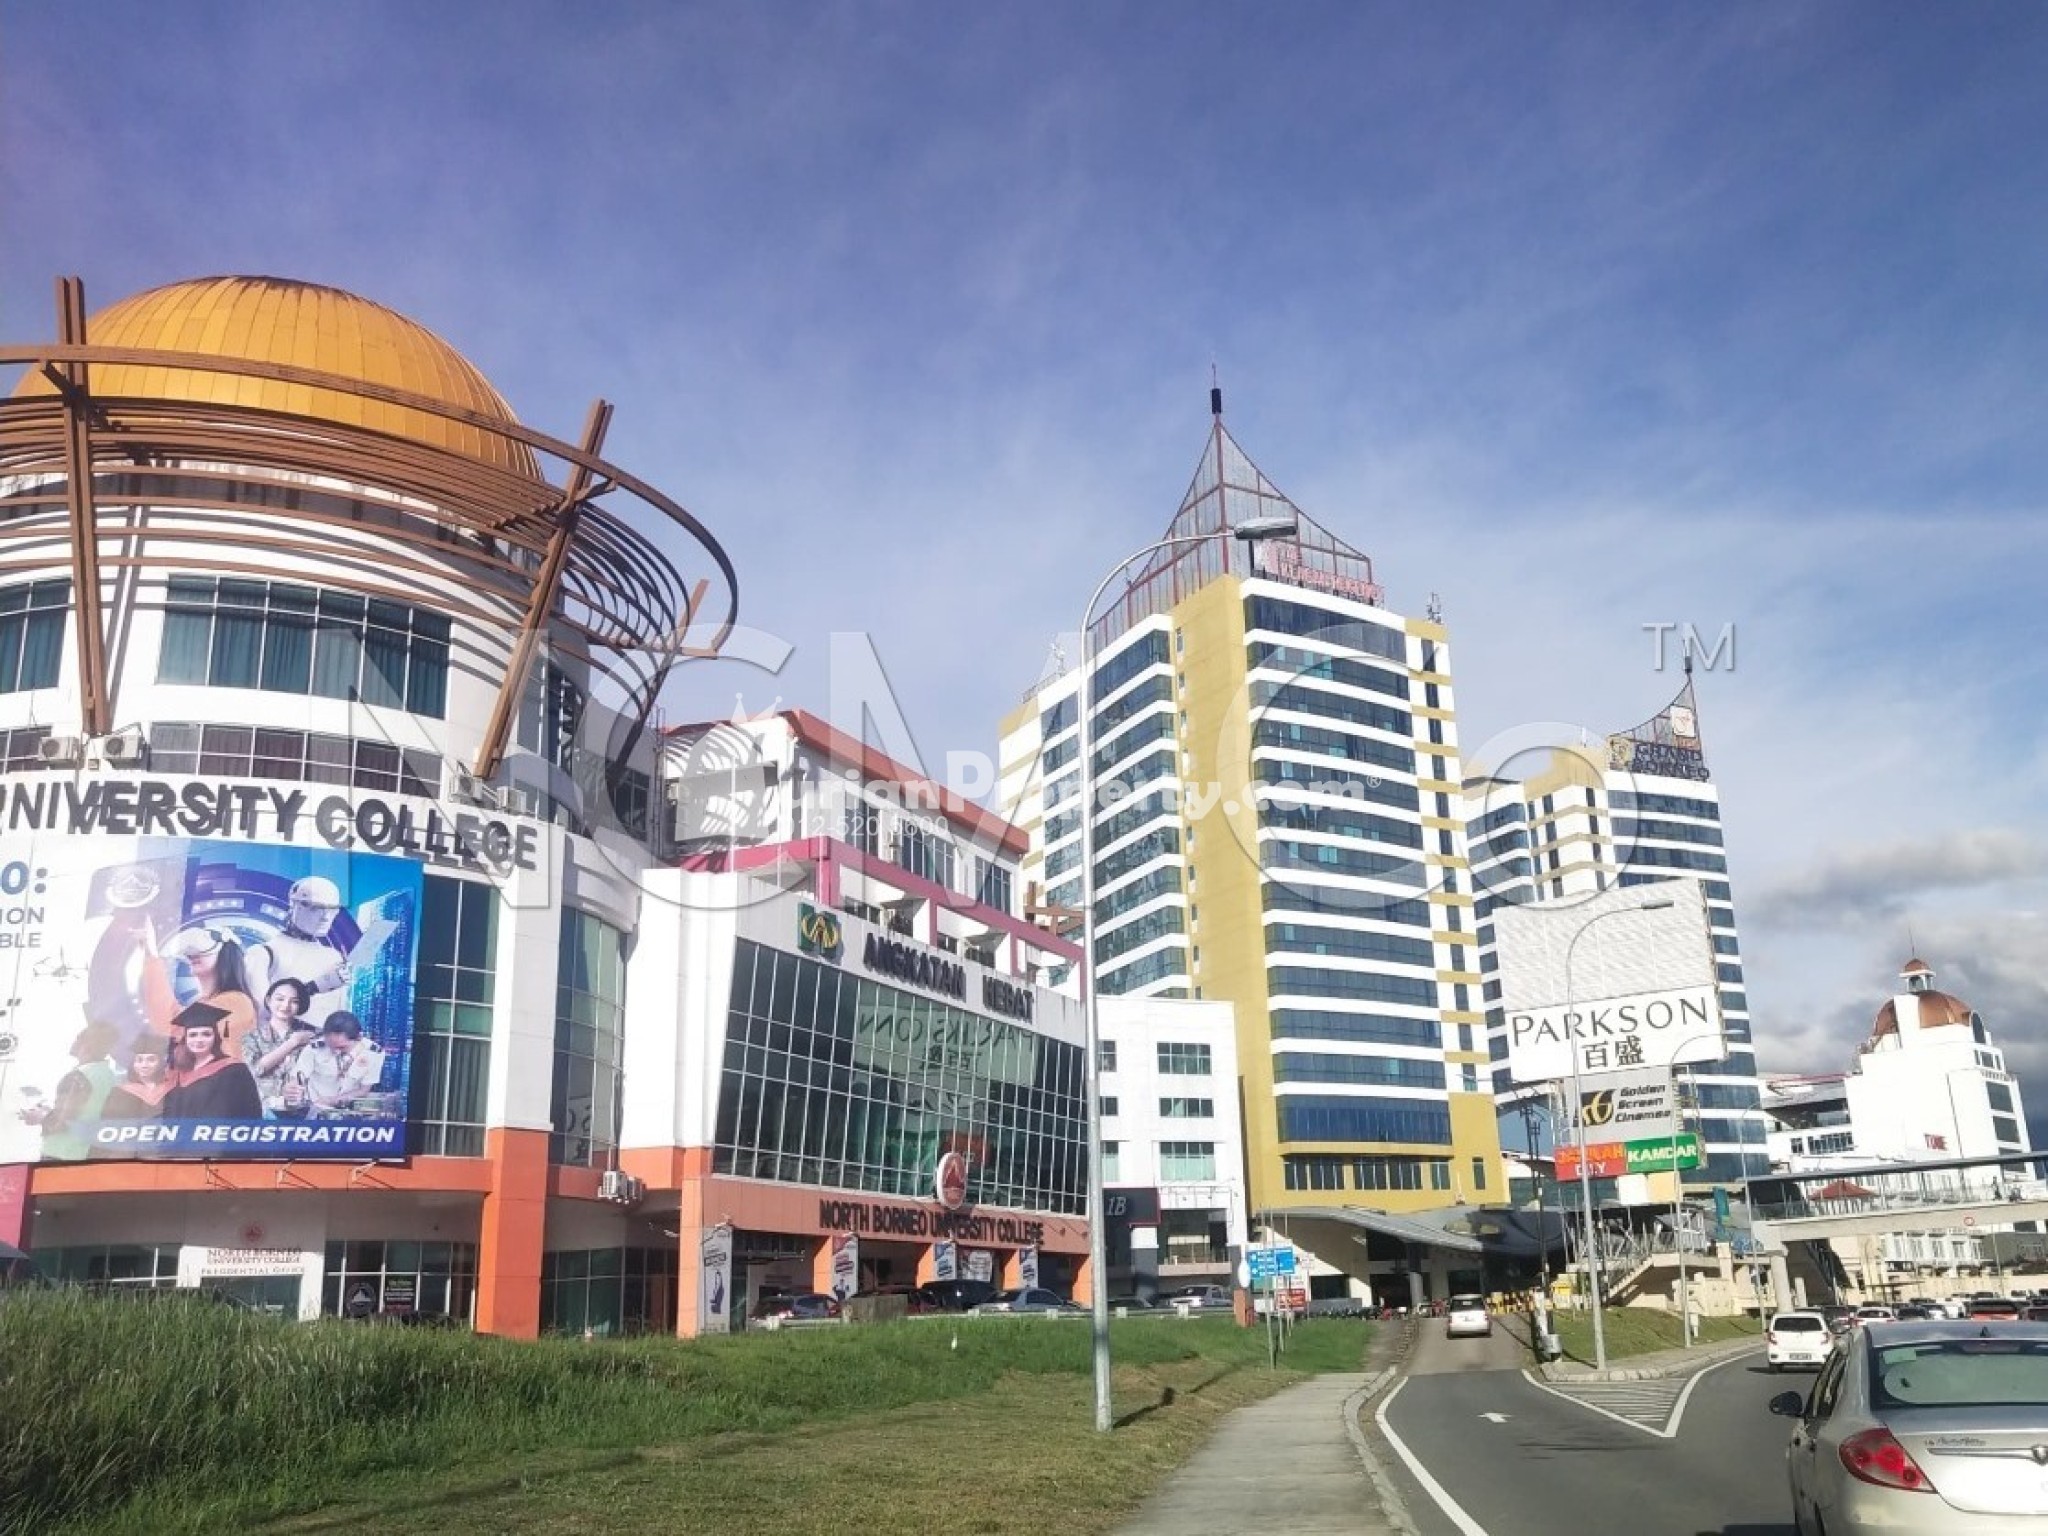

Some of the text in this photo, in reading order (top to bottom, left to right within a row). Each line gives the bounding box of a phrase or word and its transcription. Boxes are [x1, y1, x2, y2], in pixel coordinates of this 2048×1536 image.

[0, 780, 537, 874] NIVERSITY COLLEGE
[1511, 996, 1708, 1047] PARKSON
[1581, 1034, 1645, 1070] 百盛
[1620, 1084, 1666, 1097] Golden
[1618, 1097, 1664, 1110] Screen
[1615, 1110, 1671, 1122] Cinemas
[96, 1124, 395, 1144] OPEN REGISTRATION
[1627, 1144, 1698, 1163] KAMDAR
[819, 1199, 1044, 1247] NORTH BORNEO UNIVERSITY COLLEGE
